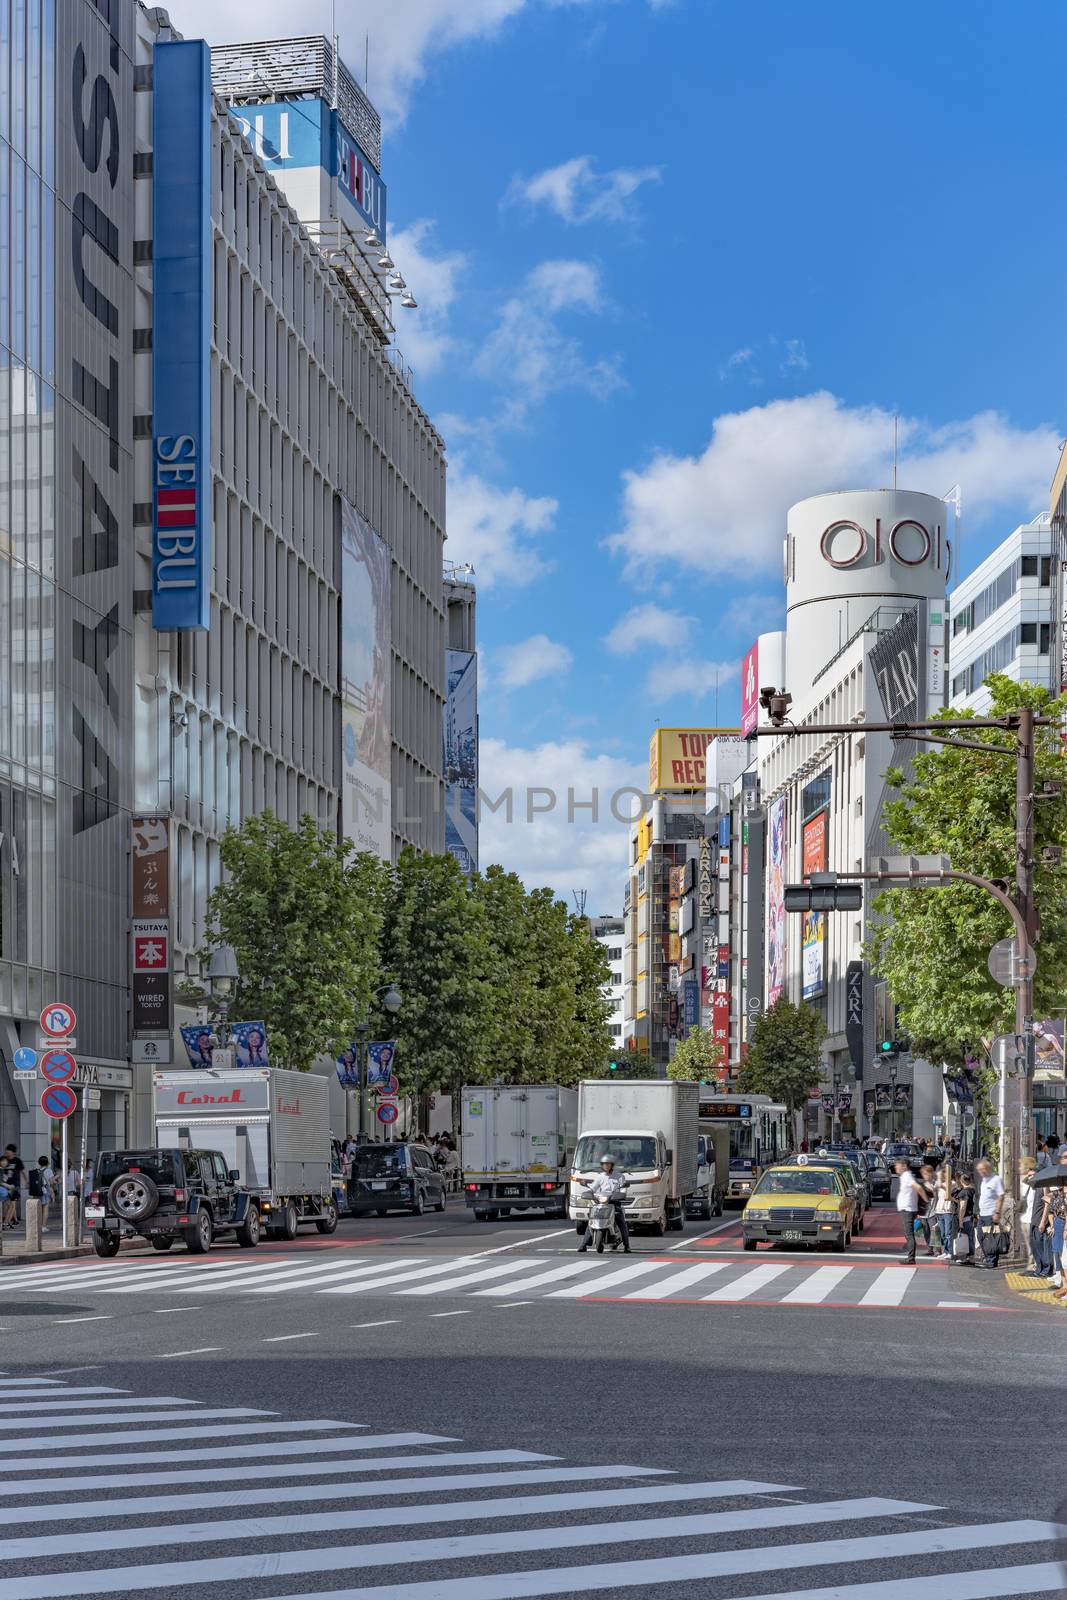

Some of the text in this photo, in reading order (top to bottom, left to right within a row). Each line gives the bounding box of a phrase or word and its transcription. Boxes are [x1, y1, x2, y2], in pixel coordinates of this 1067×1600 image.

[156, 434, 196, 593] SEIBU
[700, 836, 711, 917] KARAOKE
[139, 940, 163, 965] 本
[138, 994, 165, 1002] WIRED
[847, 971, 862, 1024] ZARA
